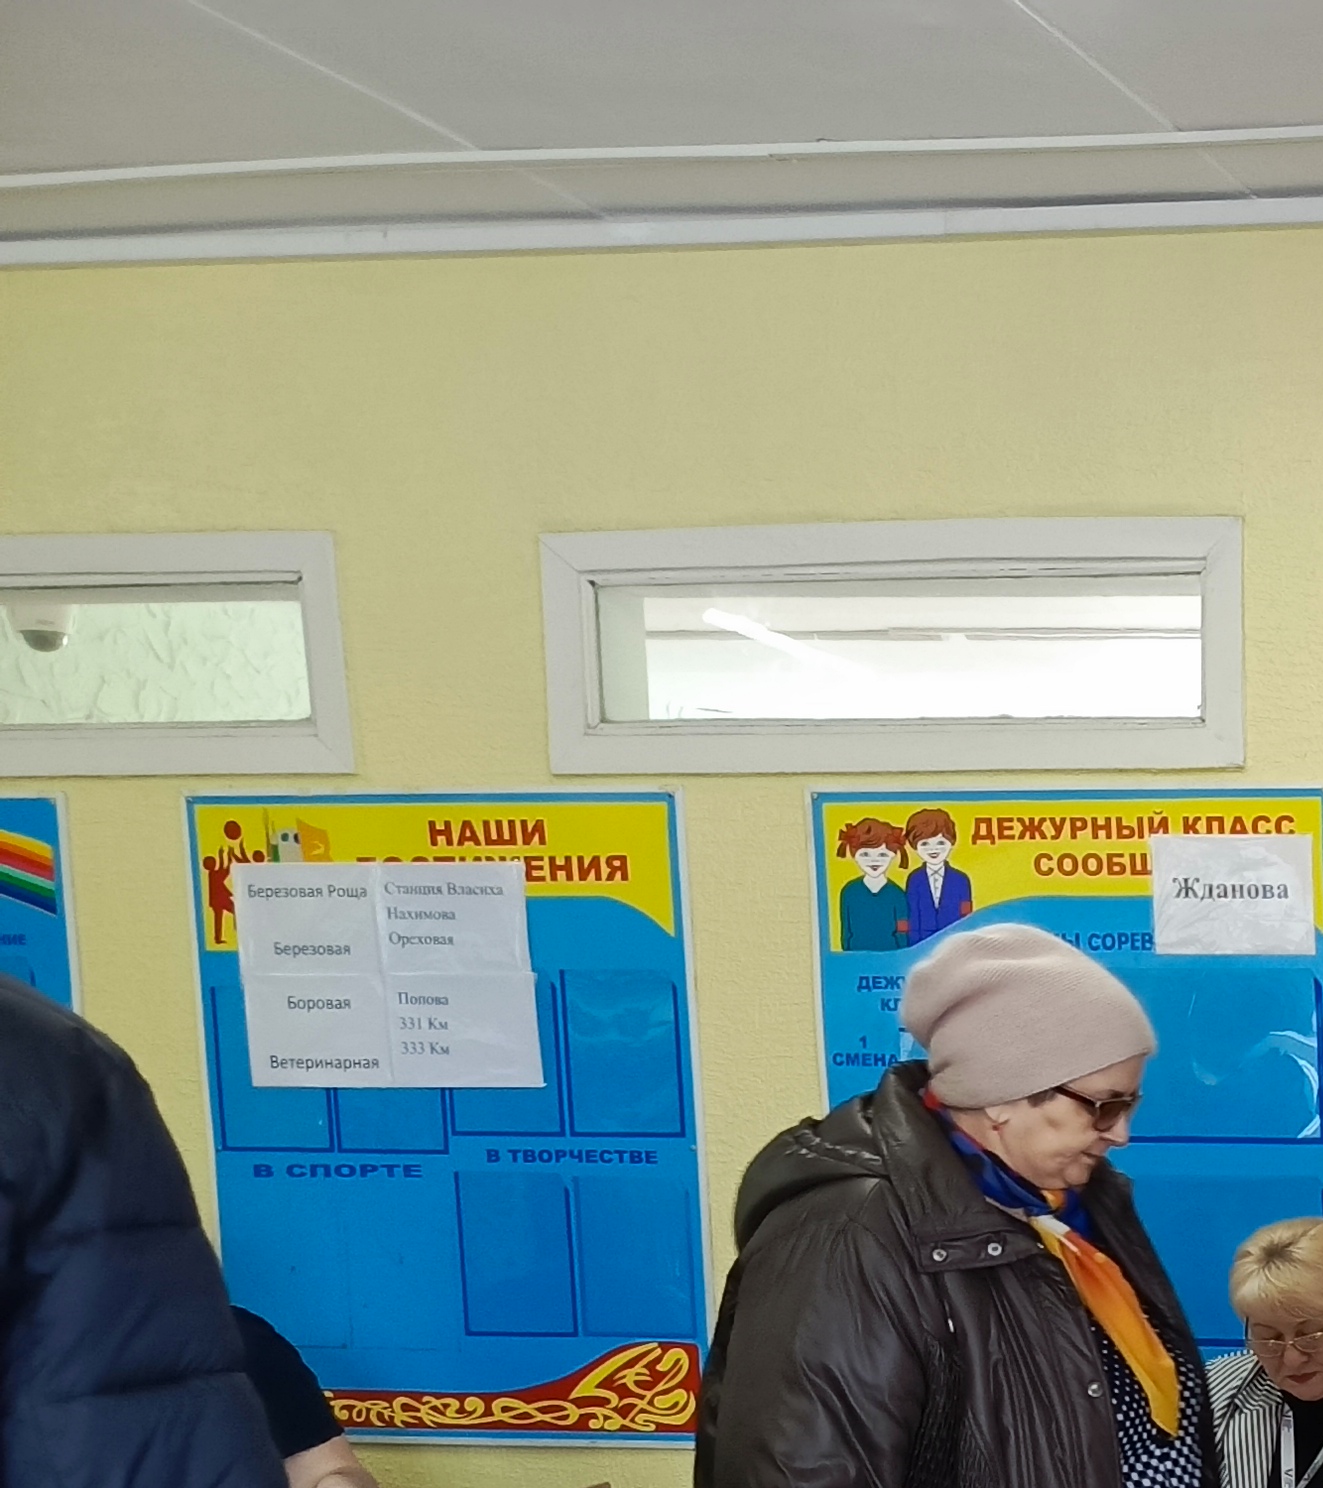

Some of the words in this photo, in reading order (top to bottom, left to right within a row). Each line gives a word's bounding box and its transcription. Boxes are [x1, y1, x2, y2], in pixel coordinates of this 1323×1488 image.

[428, 819, 547, 846] НАШИ
[971, 810, 1170, 845] ДЕЖУРНЫЙ
[248, 884, 323, 900] Березовая
[327, 885, 368, 900] Роща
[384, 881, 443, 896] Станция
[446, 881, 504, 896] Власиха
[1173, 877, 1289, 901] Жданова
[386, 907, 456, 921] Нахимова
[389, 932, 454, 948] Ореховая
[274, 943, 351, 957] Березовая
[287, 996, 351, 1011] Боровая
[398, 992, 449, 1007] Попова
[399, 1017, 423, 1030] 331
[428, 1017, 448, 1030] Км
[401, 1041, 425, 1055] 333
[430, 1041, 449, 1055] Км
[859, 1036, 867, 1049] 1
[270, 1055, 379, 1071] Ветеринарная
[832, 1053, 898, 1066] СМЕНА
[486, 1149, 500, 1163] В
[508, 1149, 658, 1164] ТВОРЧЕСТВЕ
[253, 1164, 274, 1178] В
[286, 1163, 422, 1178] СПОРТЕ
